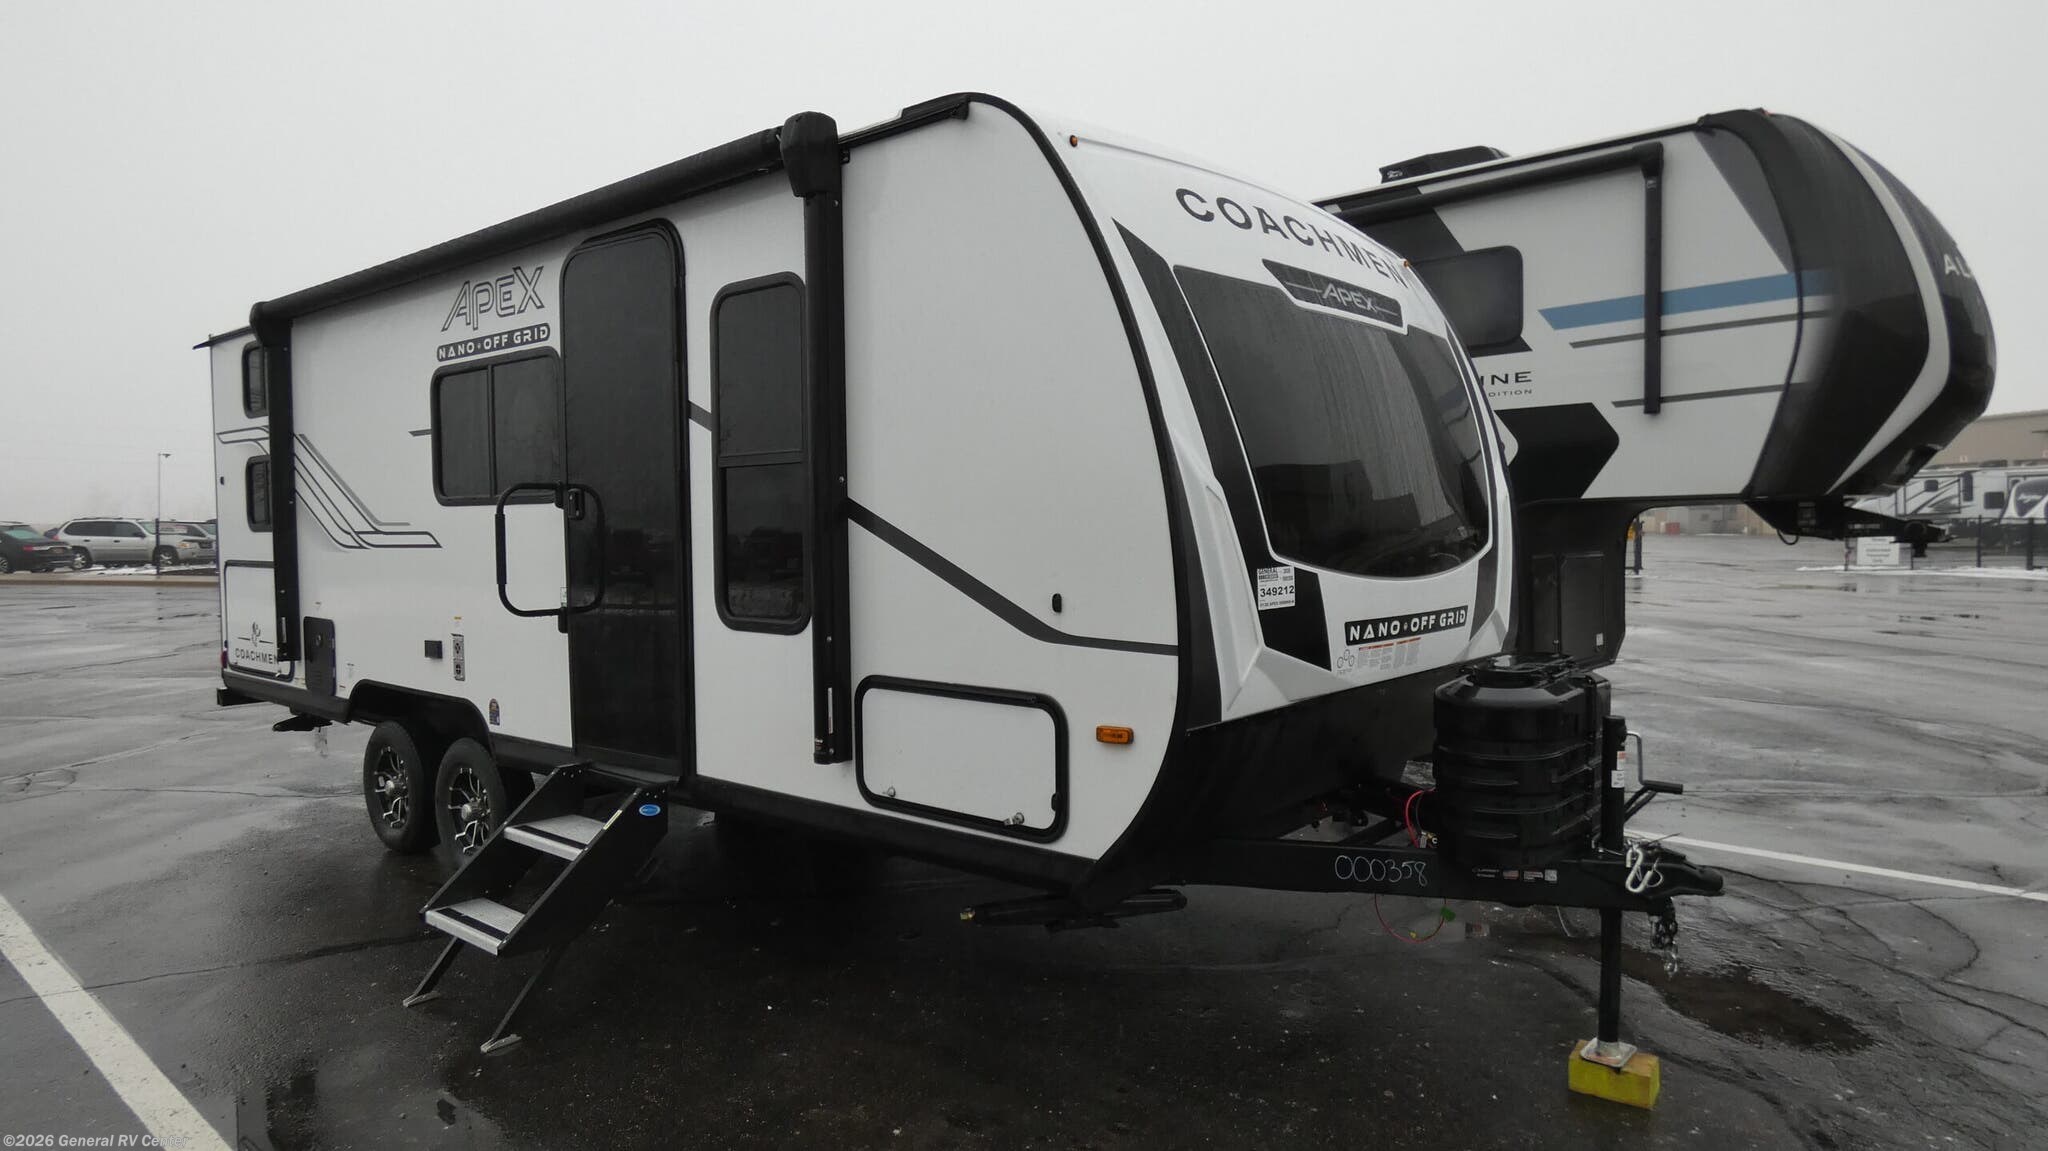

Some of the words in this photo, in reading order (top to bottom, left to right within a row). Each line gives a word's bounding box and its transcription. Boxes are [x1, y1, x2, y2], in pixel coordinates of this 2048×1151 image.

[1176, 188, 1409, 289] COACHMEN
[441, 266, 545, 332] APEX
[1322, 283, 1377, 313] APEX
[439, 342, 475, 359] NANO
[483, 334, 508, 350] OFF
[513, 326, 548, 344] GRID
[1260, 585, 1295, 598] 349212
[1350, 620, 1400, 641] NANO
[1410, 614, 1436, 632] OFF
[1440, 609, 1466, 627] GRID
[1335, 855, 1428, 887] 000358
